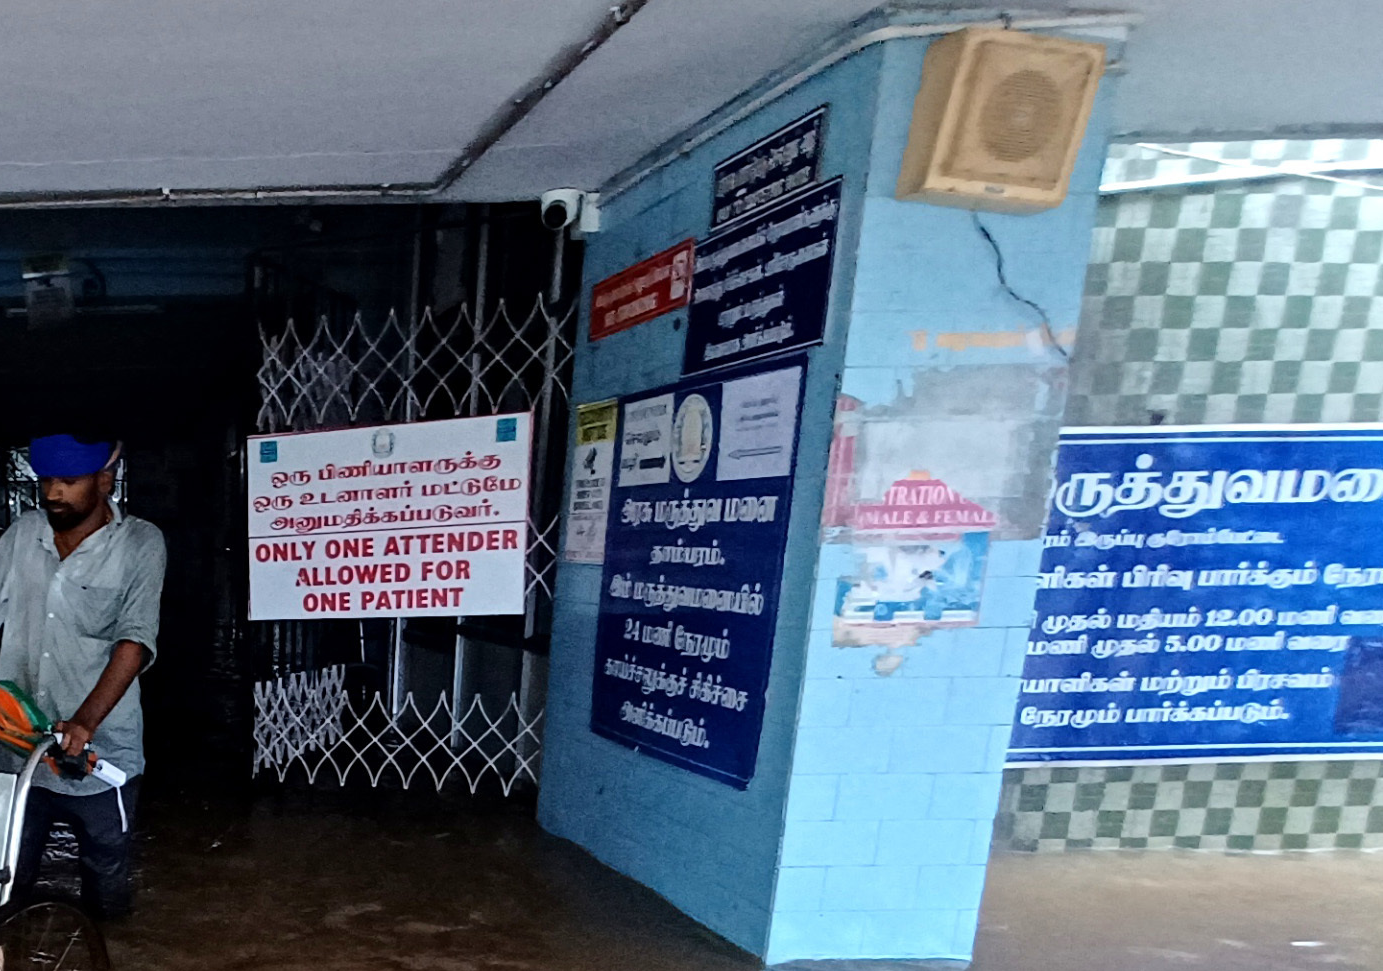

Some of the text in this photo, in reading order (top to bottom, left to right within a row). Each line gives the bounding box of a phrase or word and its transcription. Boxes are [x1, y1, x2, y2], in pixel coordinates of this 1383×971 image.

[271, 451, 502, 488] ஒரு பிணியாளருக்கு
[253, 475, 522, 512] ஒரு உடனாளர் மட்டுமே
[269, 499, 501, 533] அனுமதிக்கப்படுவர்.
[915, 510, 929, 524] &
[255, 529, 518, 563] ONLY ONE ATTENDER
[296, 559, 471, 587] ALLOWED FOR
[1121, 563, 1192, 590] பிரிவு
[1198, 560, 1318, 589] பார்க்கும்
[303, 587, 464, 612] ONE PATIENT
[623, 618, 640, 640] 24
[1042, 607, 1111, 634] முதல்
[1205, 608, 1273, 627] 12.00
[1091, 633, 1160, 659] முதல்
[1164, 635, 1222, 653] 5.00
[1140, 668, 1233, 697] மற்றும்
[1020, 702, 1121, 729] நேரமும்
